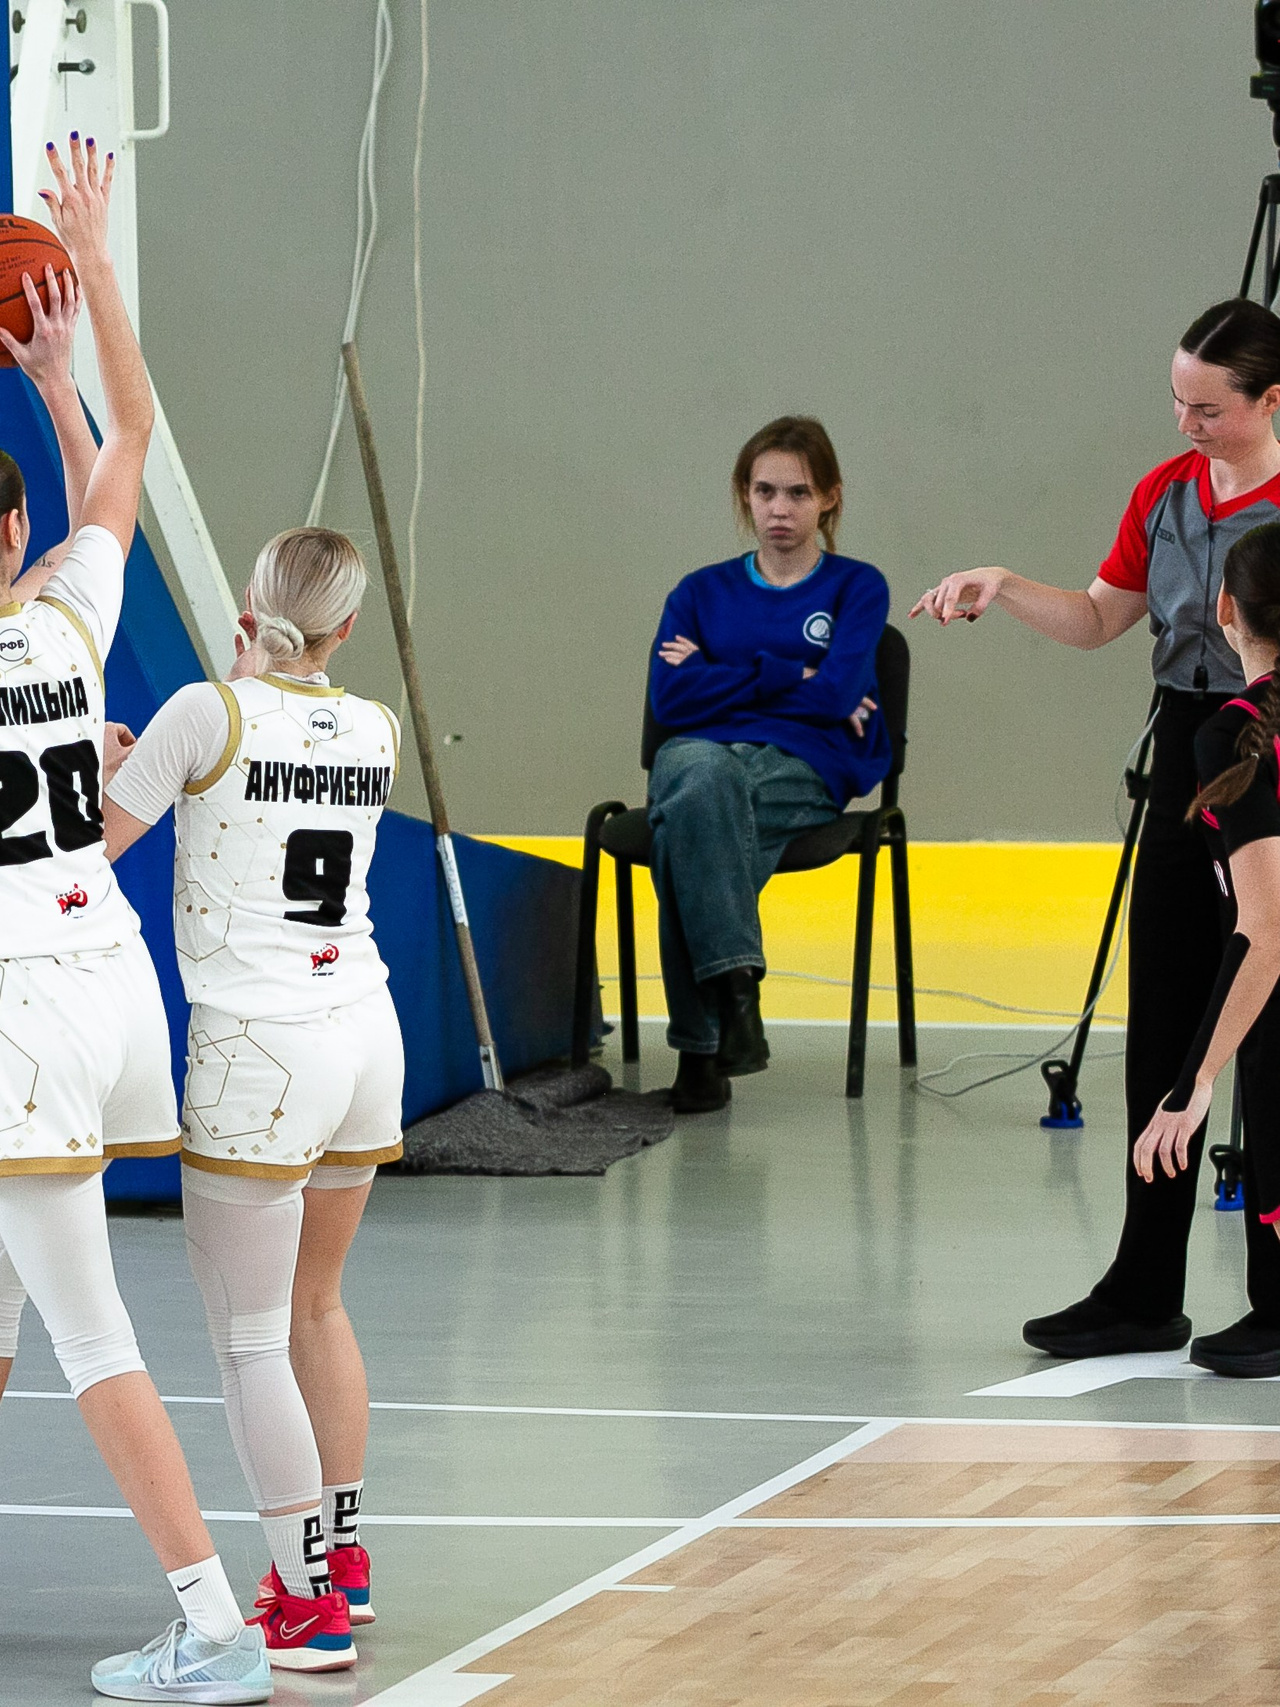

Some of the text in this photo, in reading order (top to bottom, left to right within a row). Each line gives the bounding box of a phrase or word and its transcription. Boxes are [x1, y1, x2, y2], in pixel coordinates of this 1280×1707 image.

[0, 639, 25, 652] РФБ
[311, 720, 335, 730] РФБ
[244, 760, 391, 807] АНУФРИЕНКО
[282, 829, 354, 927] 9
